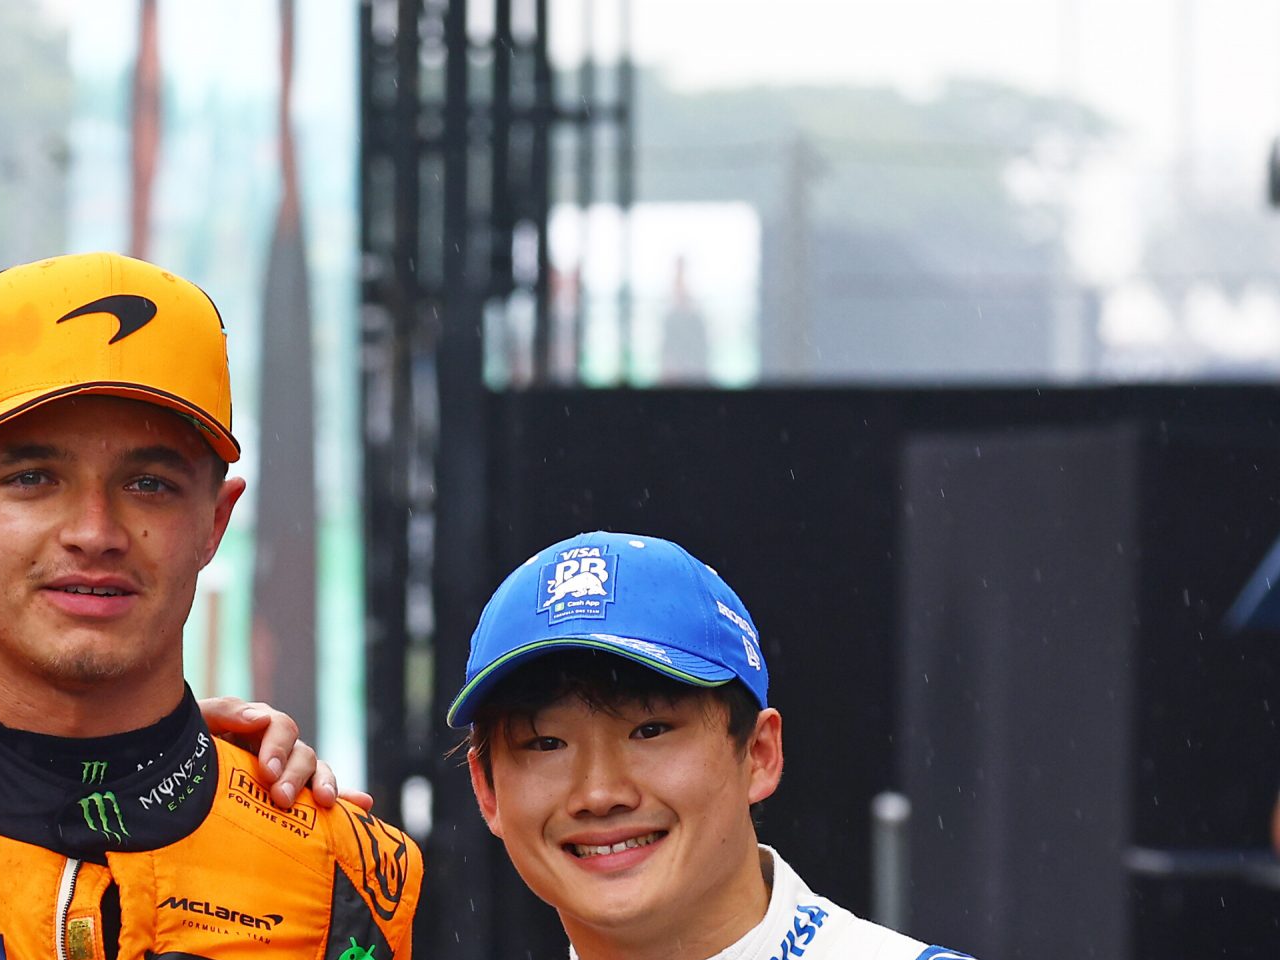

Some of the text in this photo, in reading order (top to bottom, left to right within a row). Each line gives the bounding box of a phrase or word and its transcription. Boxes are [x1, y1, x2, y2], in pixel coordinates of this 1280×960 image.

[560, 547, 601, 560] VISA
[138, 732, 210, 810] MONSER
[167, 764, 207, 811] ENER
[228, 793, 310, 839] FOR THE STAY
[238, 774, 308, 822] Hiln
[156, 896, 272, 931] McLaren
